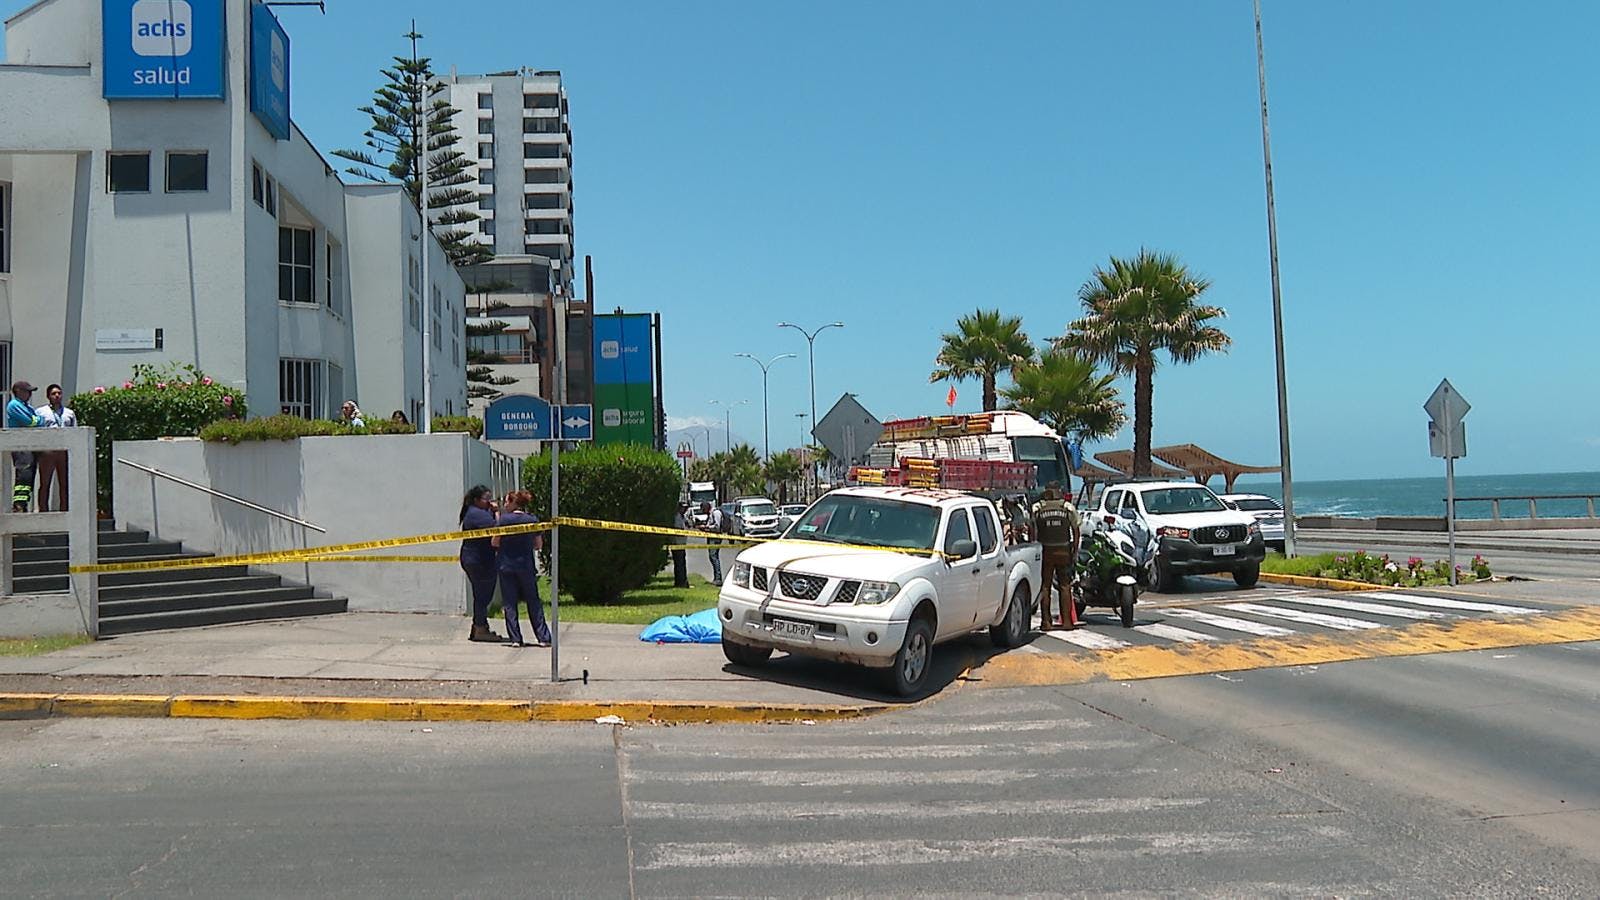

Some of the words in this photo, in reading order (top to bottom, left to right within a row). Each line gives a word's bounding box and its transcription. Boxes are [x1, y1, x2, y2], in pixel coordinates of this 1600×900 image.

[138, 19, 186, 37] achs
[133, 67, 190, 85] salud
[501, 411, 535, 420] GENERAL
